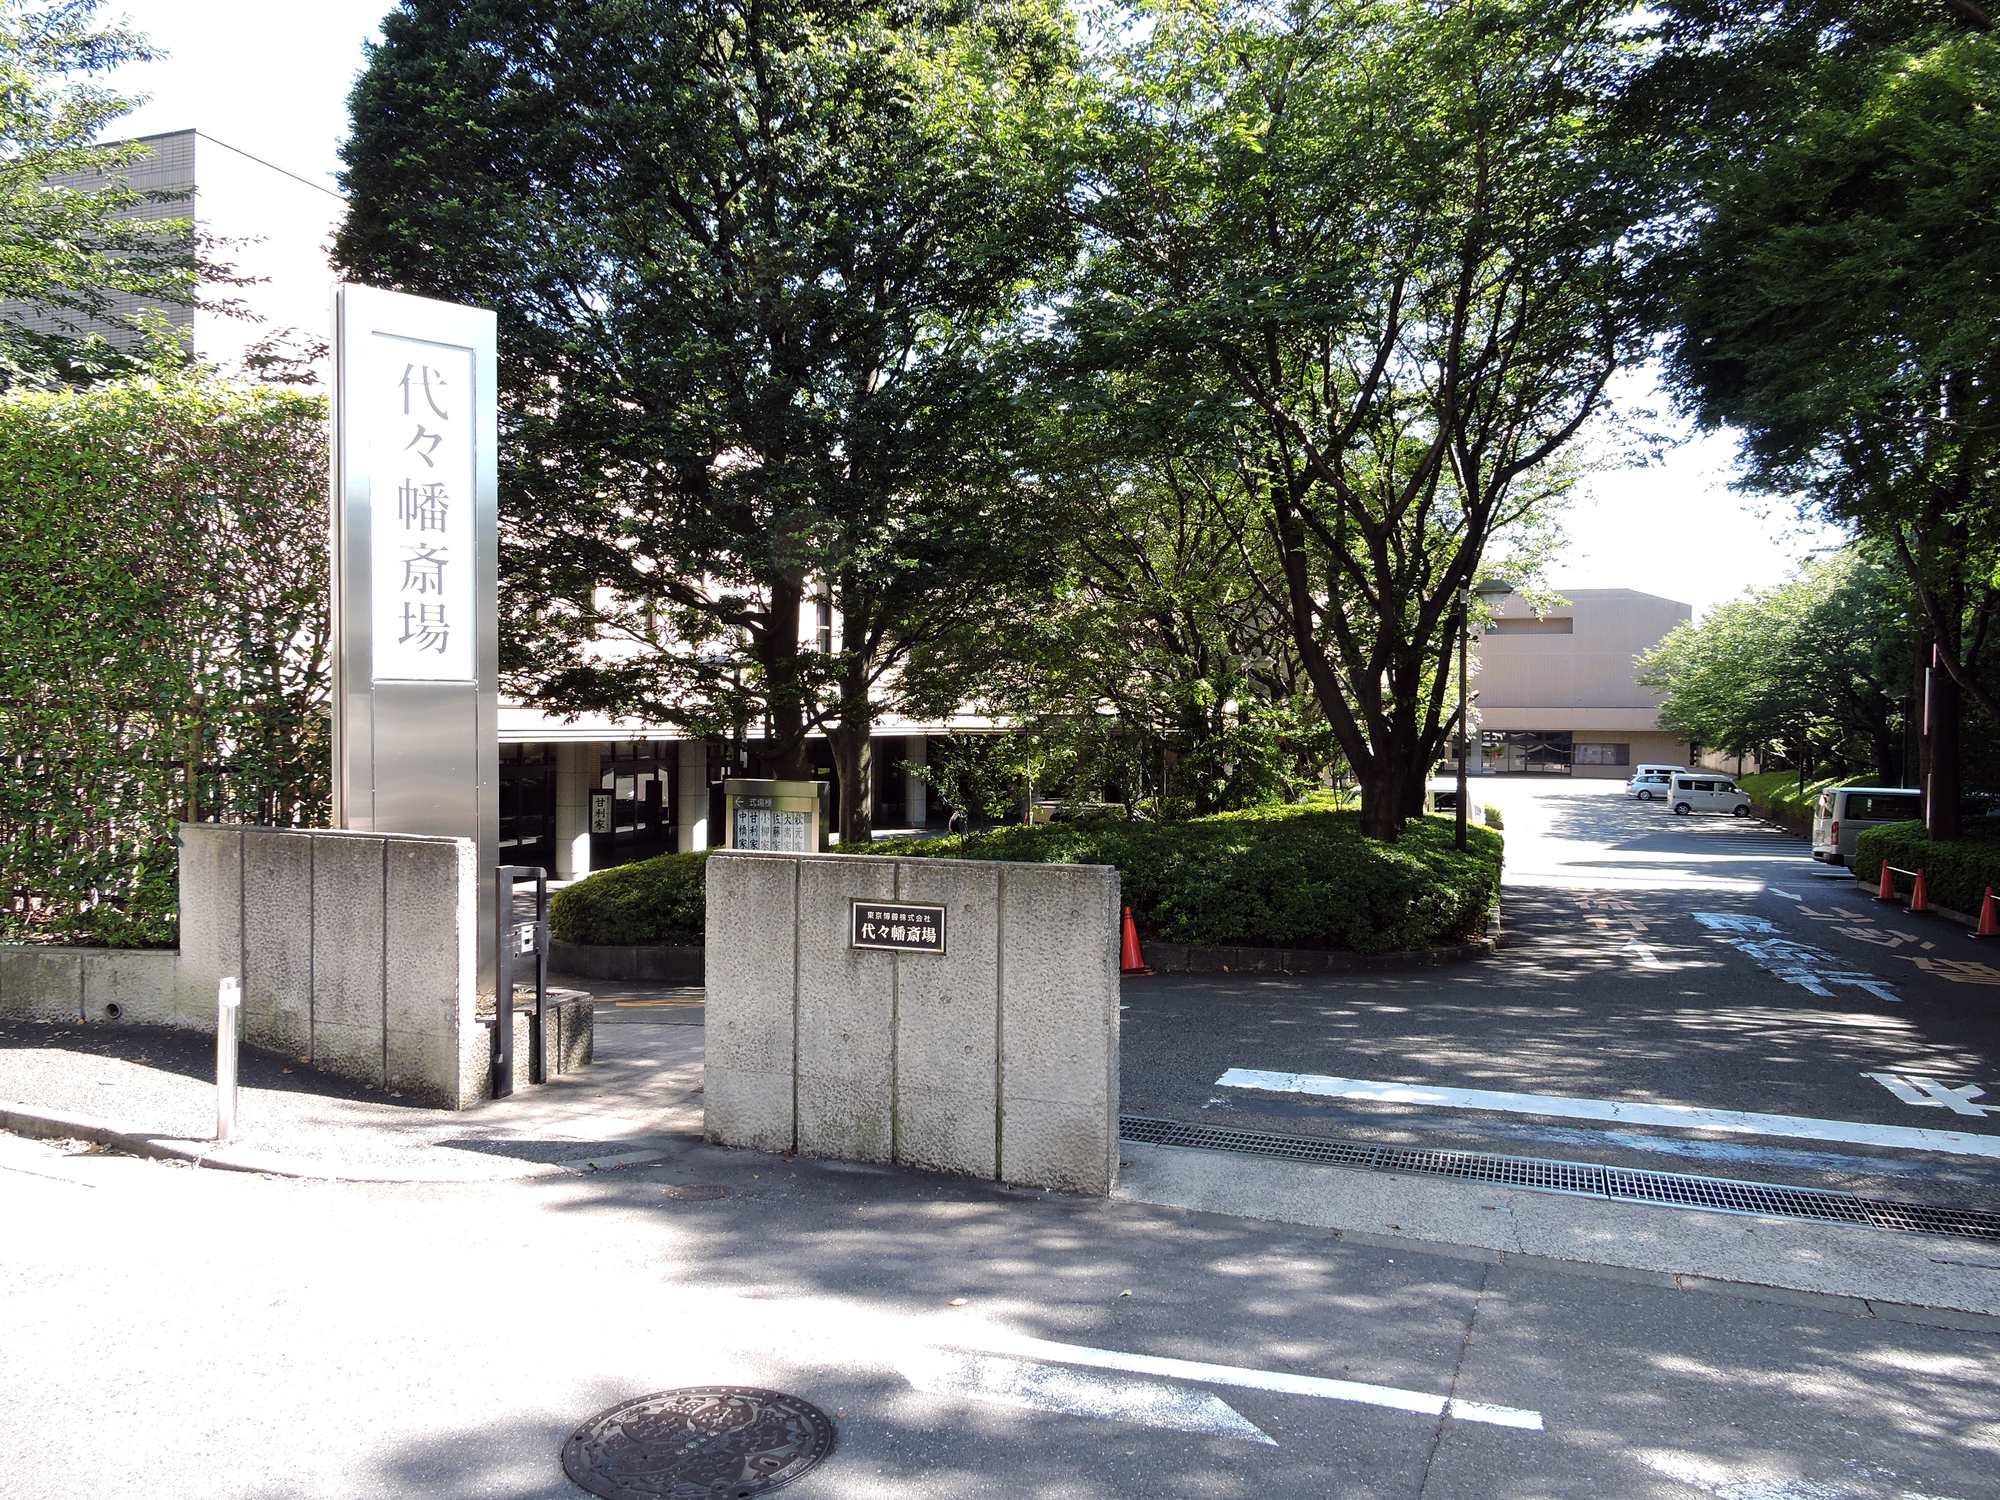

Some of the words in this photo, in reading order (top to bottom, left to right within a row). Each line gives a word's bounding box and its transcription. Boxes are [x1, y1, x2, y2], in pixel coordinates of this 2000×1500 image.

[397, 362, 450, 654] 代々幡斎場
[594, 798, 606, 830] 甘利家
[738, 811, 748, 849] 中橋家
[749, 811, 759, 850] 甘利家
[772, 813, 782, 851] 佐藤家
[861, 922, 937, 943] 代々幡斎場
